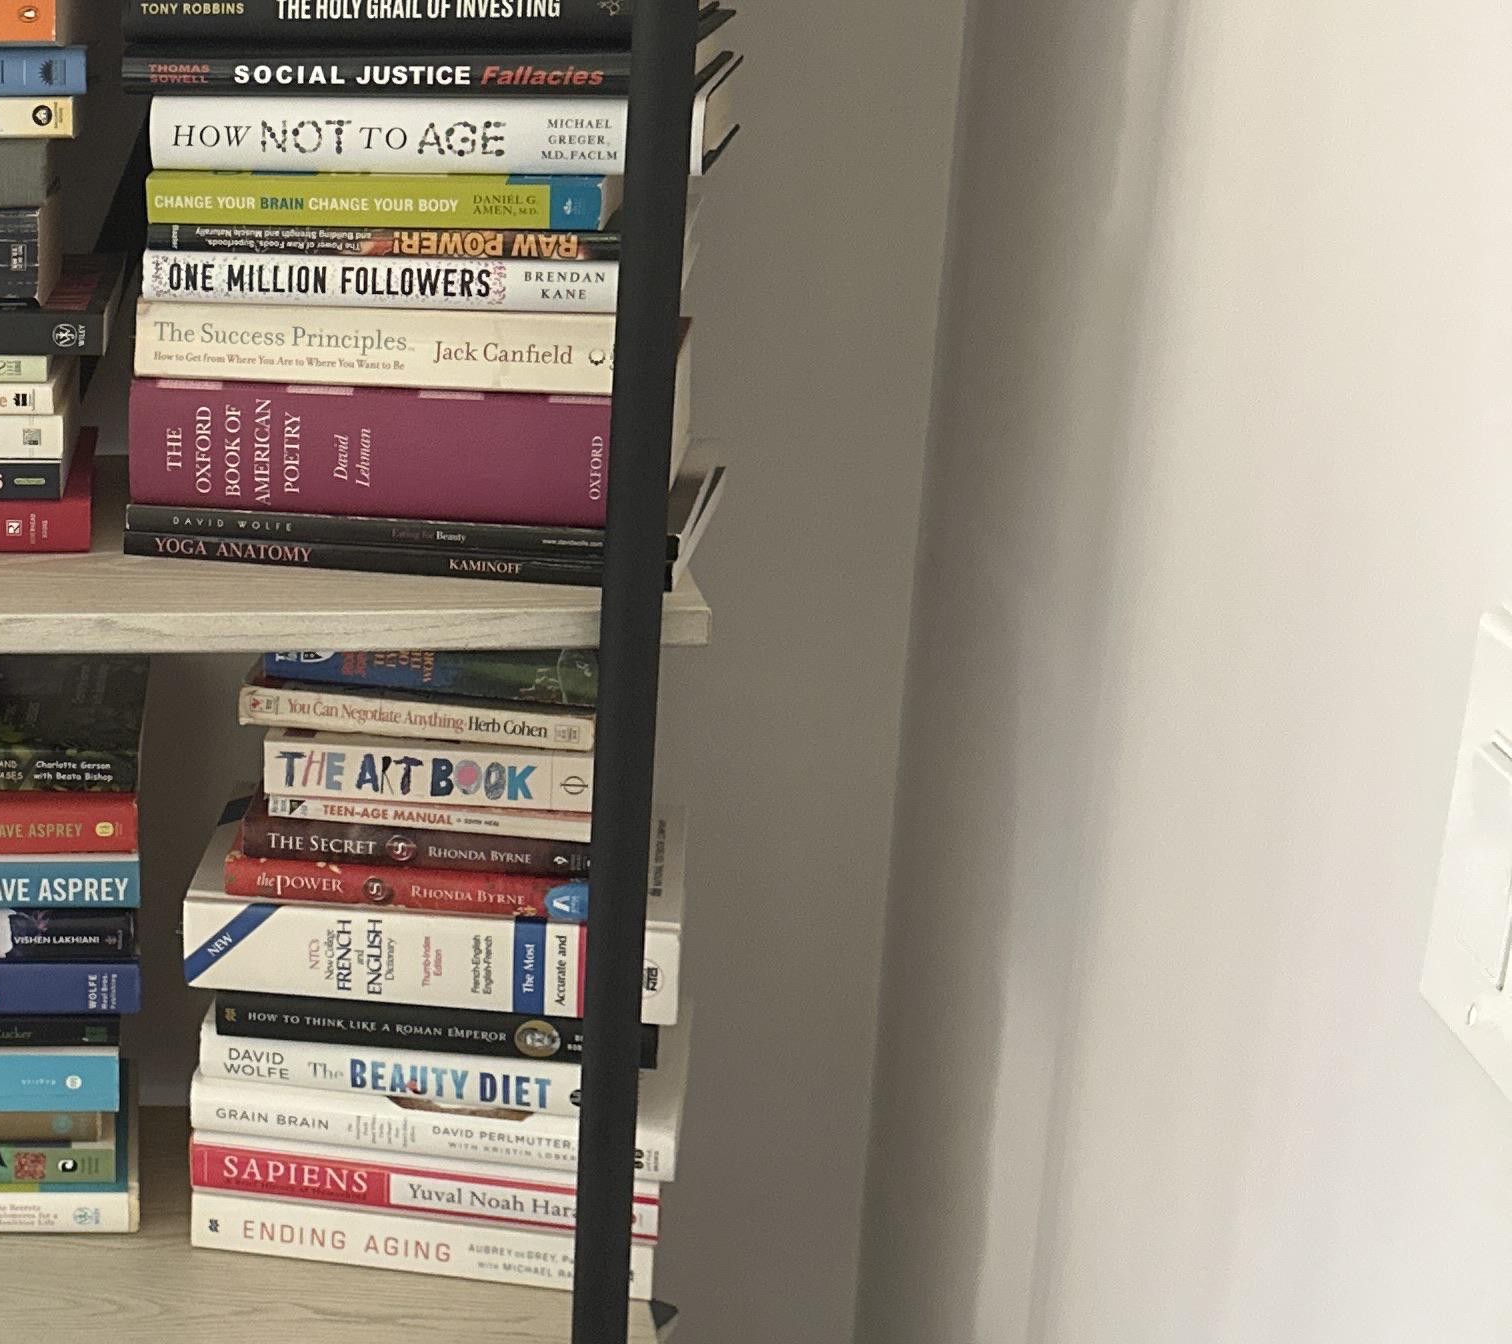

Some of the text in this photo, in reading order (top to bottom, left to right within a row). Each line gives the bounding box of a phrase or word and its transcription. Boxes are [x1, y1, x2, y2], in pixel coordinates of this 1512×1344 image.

[141, 2, 244, 14] TONY ROBBINS
[233, 65, 604, 85] SOCIAL JUSTICE Fallacies
[168, 264, 490, 298] ONE MILLION FOLLOWERS
[524, 271, 606, 283] BRENDAN
[540, 288, 587, 300] KANE
[154, 322, 407, 353] The Success Principles
[38, 877, 129, 903] ASPREY
[223, 1155, 369, 1193] SAPIENS
[243, 1220, 451, 1263] ENDING AGING
